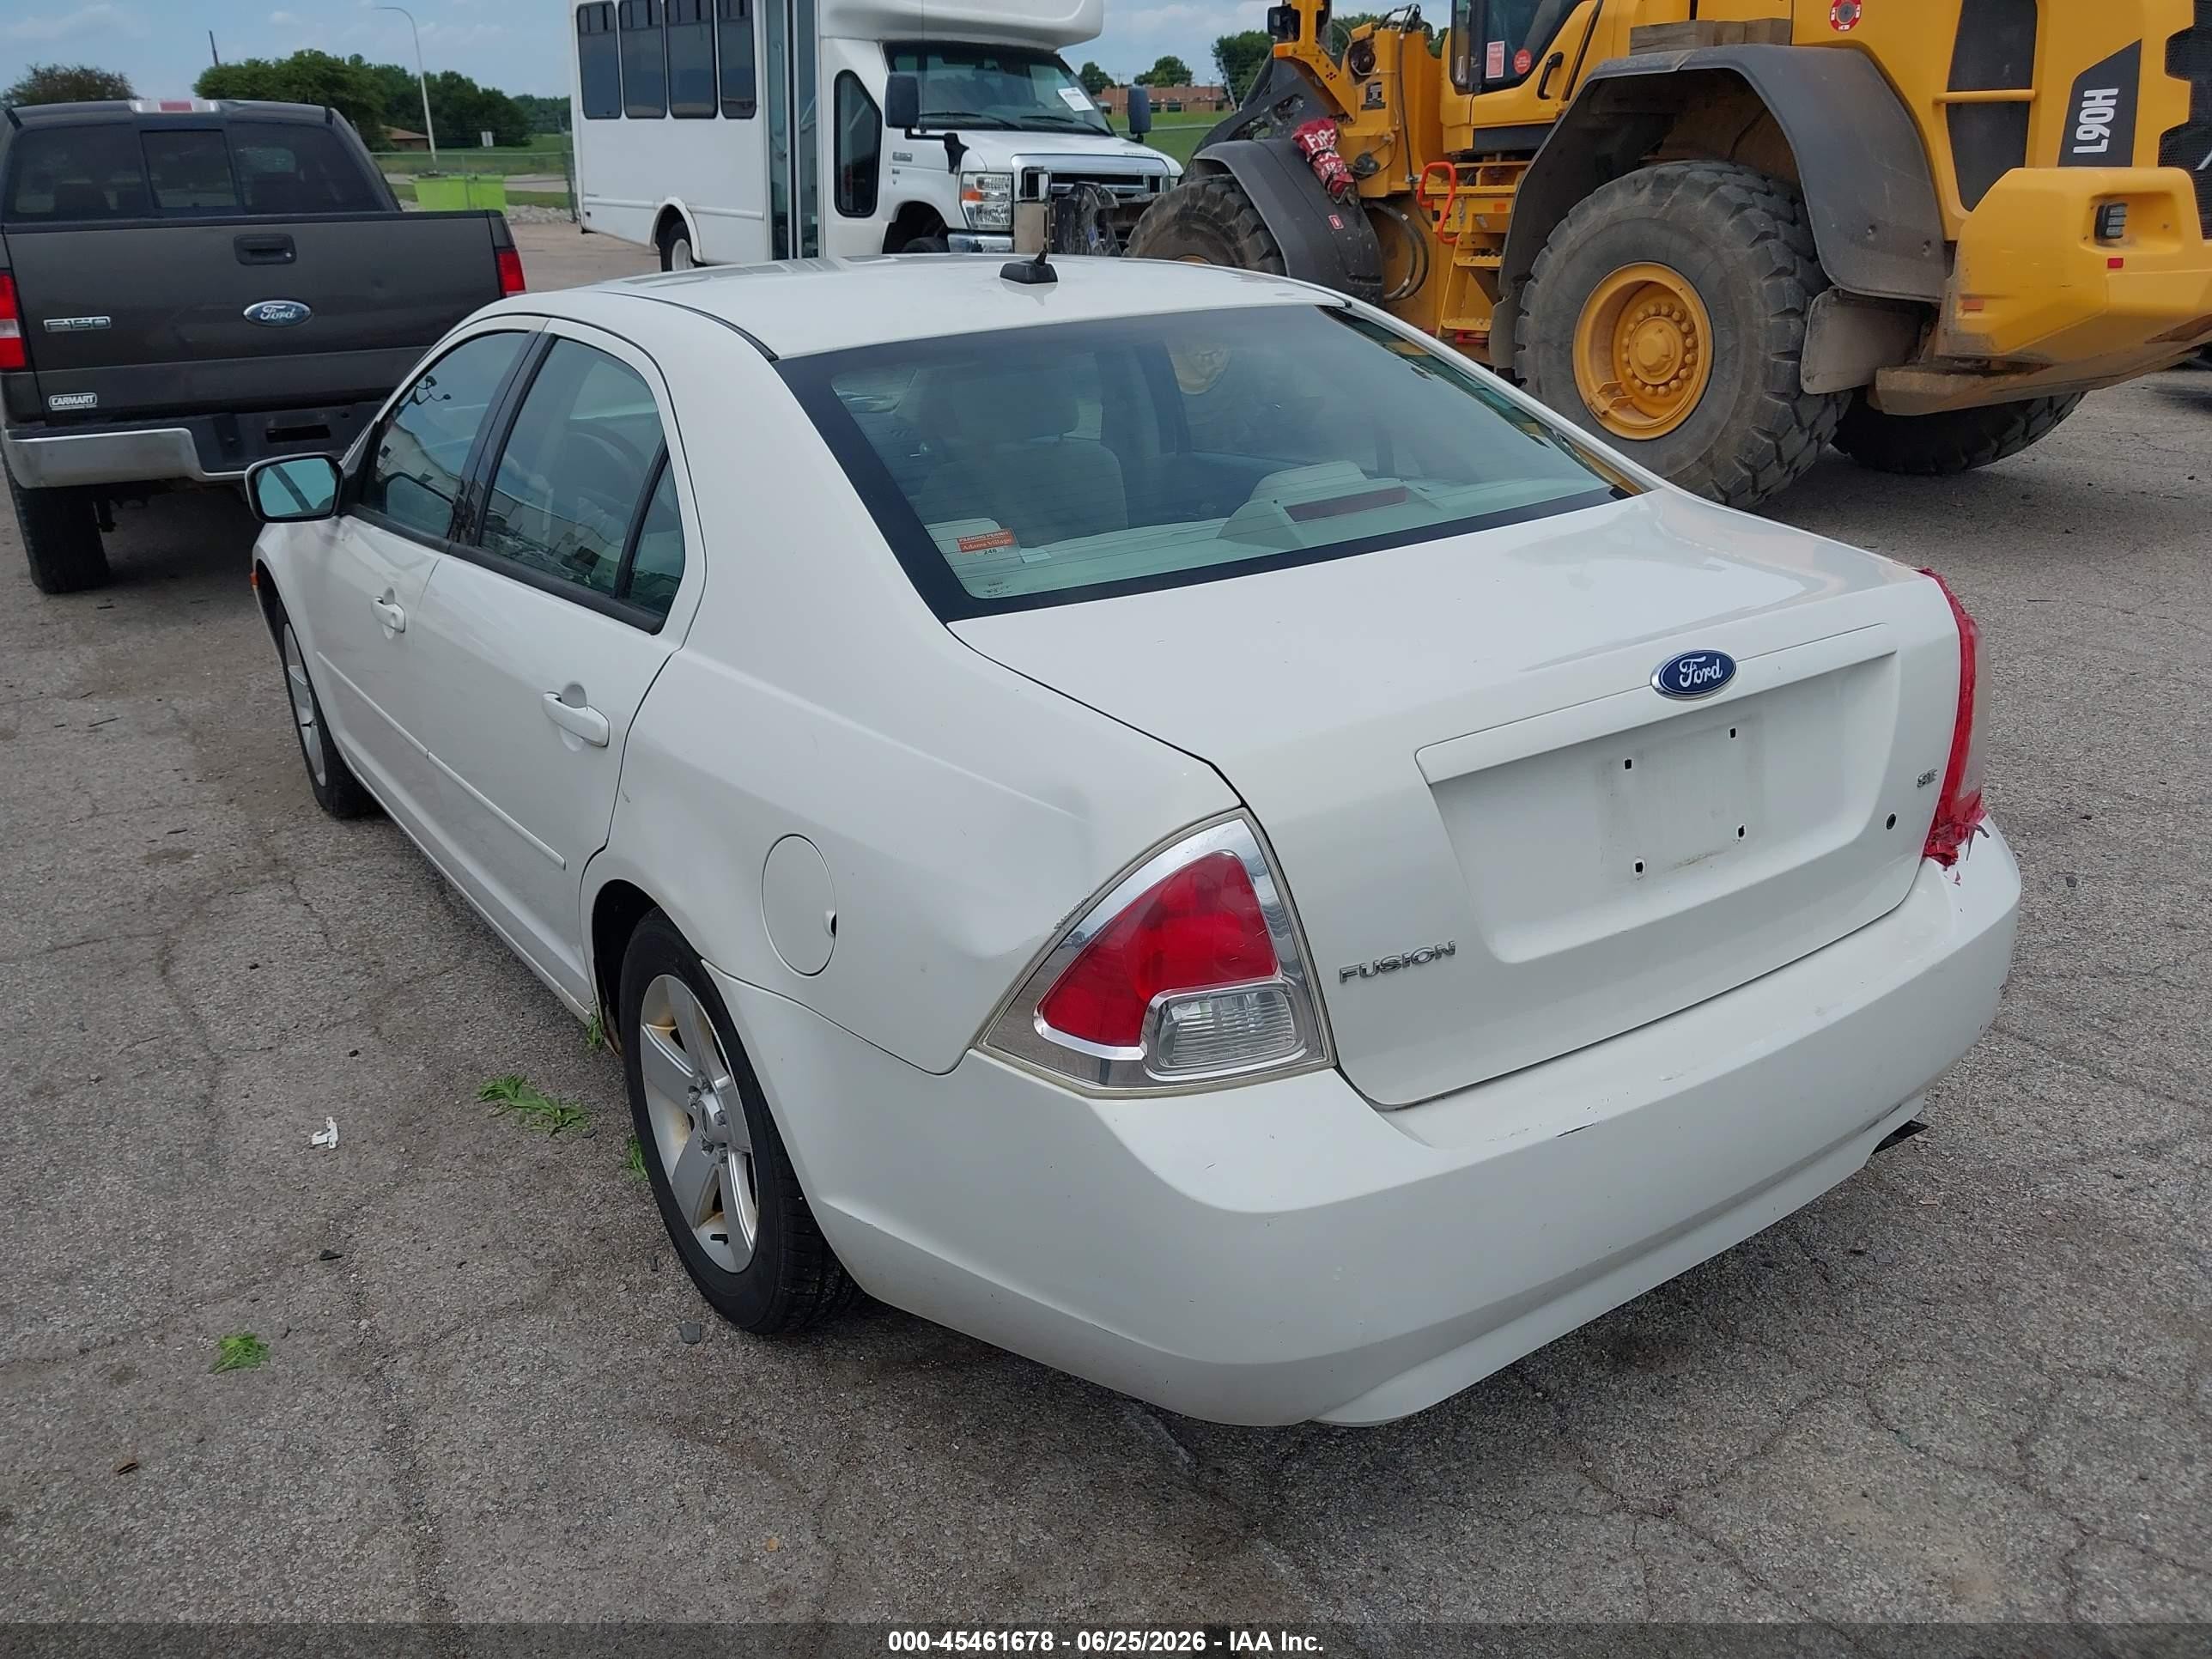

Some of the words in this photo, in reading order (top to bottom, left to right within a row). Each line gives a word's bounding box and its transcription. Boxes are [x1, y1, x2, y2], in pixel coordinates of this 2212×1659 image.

[2073, 88, 2119, 153] L90H
[260, 305, 296, 320] Ford
[52, 395, 94, 405] CARMART
[1679, 655, 1723, 688] Ford
[1339, 940, 1456, 983] FUSION
